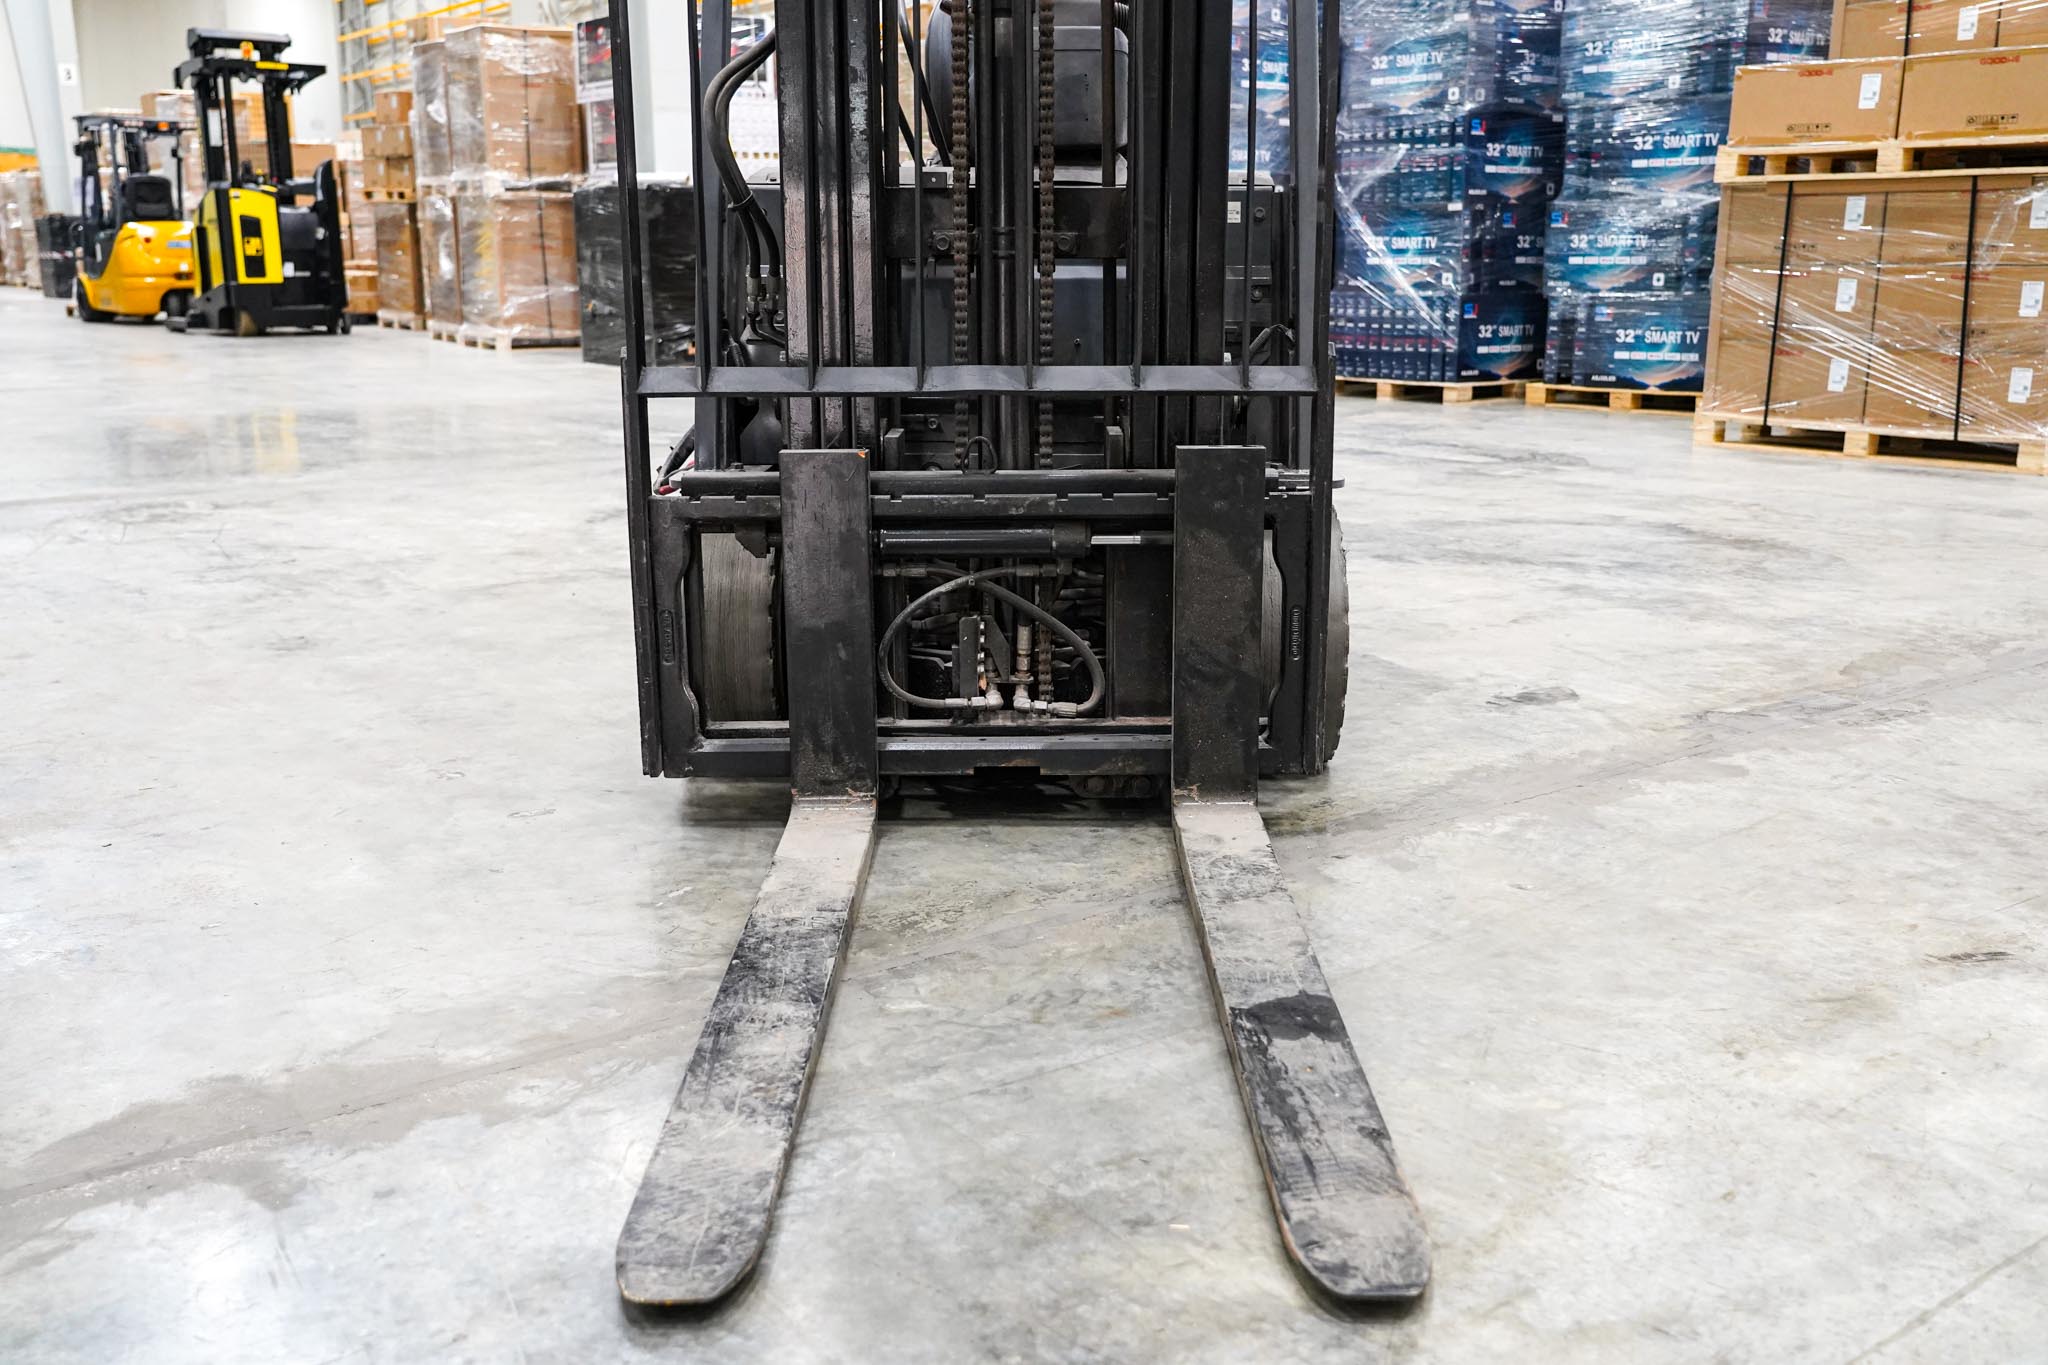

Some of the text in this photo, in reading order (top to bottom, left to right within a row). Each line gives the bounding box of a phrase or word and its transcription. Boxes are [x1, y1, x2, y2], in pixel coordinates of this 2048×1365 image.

[1396, 53, 1428, 67] SMART
[1634, 132, 1719, 151] 32" SMART TV
[1486, 143, 1543, 157] 32" SMART TV
[1391, 236, 1422, 249] SMART
[1424, 236, 1437, 249] TV
[1596, 234, 1634, 248] SMART
[1478, 324, 1535, 338] 32" SMART TV
[1615, 328, 1700, 344] 32" SMART TV
